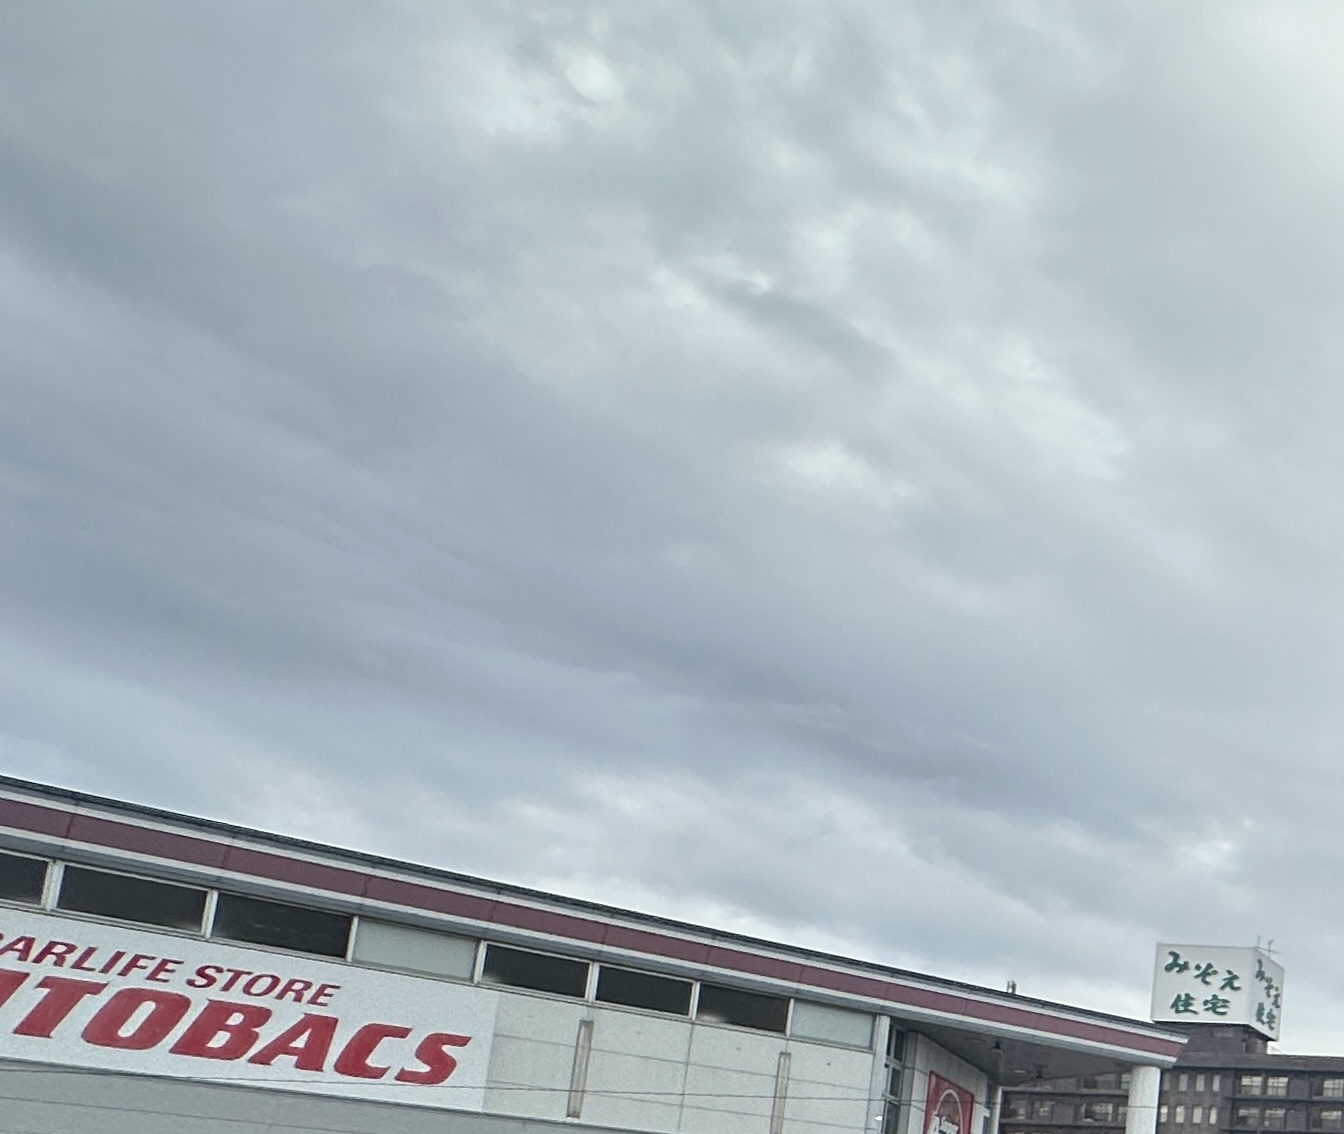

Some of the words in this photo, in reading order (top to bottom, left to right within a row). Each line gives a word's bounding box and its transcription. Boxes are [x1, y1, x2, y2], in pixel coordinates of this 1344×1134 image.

[0, 933, 184, 984] ARLIFE
[186, 964, 341, 1008] STORE
[1170, 992, 1231, 1016] 住宅
